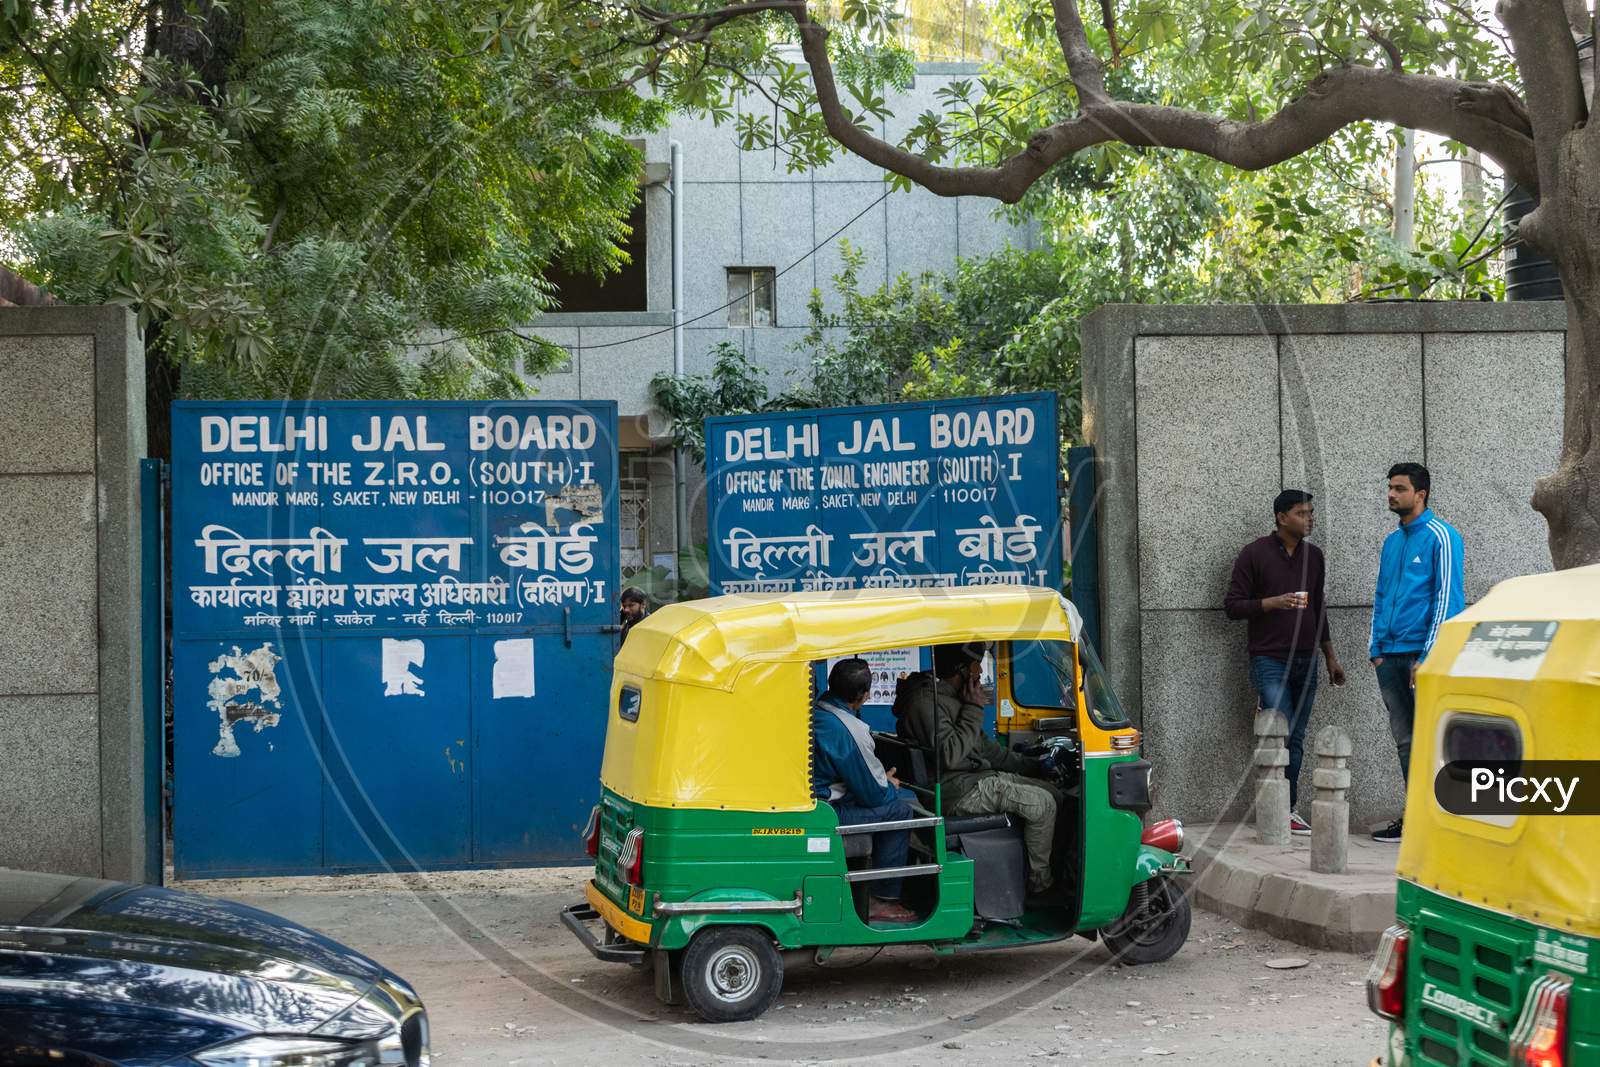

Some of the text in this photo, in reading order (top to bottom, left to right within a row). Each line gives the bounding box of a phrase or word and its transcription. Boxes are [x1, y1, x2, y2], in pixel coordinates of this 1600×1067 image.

[201, 415, 596, 452] DELHI JAL BOARD
[725, 407, 1035, 462] DELHI JAL BOARD
[200, 462, 264, 486] OFFICE
[276, 462, 299, 486] OF
[307, 462, 352, 486] THE
[364, 461, 461, 486] Z.R.O.
[725, 470, 767, 495] OFFICE
[768, 469, 784, 493] OF
[787, 467, 815, 491] THE
[820, 464, 860, 491] ZONAL
[863, 459, 930, 488] ENGINEER
[232, 491, 279, 506] MANDIR
[390, 491, 418, 505] NEW
[423, 491, 460, 505] DELHI
[482, 490, 546, 505] 110017
[742, 497, 775, 512] MANDIR
[860, 492, 881, 507] NEW
[888, 491, 917, 506] DELHI
[943, 487, 997, 503] 110017
[194, 521, 599, 577] दिल्ली जल बोर्ड
[722, 514, 1042, 571] दिल्ली जल बोर्ड
[189, 577, 283, 609] कार्यालय
[353, 583, 418, 608] राजस्व
[420, 574, 510, 607] अधिकारी
[287, 610, 317, 626] मार्ग
[334, 610, 376, 626] साकेत
[402, 609, 430, 627] नई
[486, 612, 523, 624] 110017
